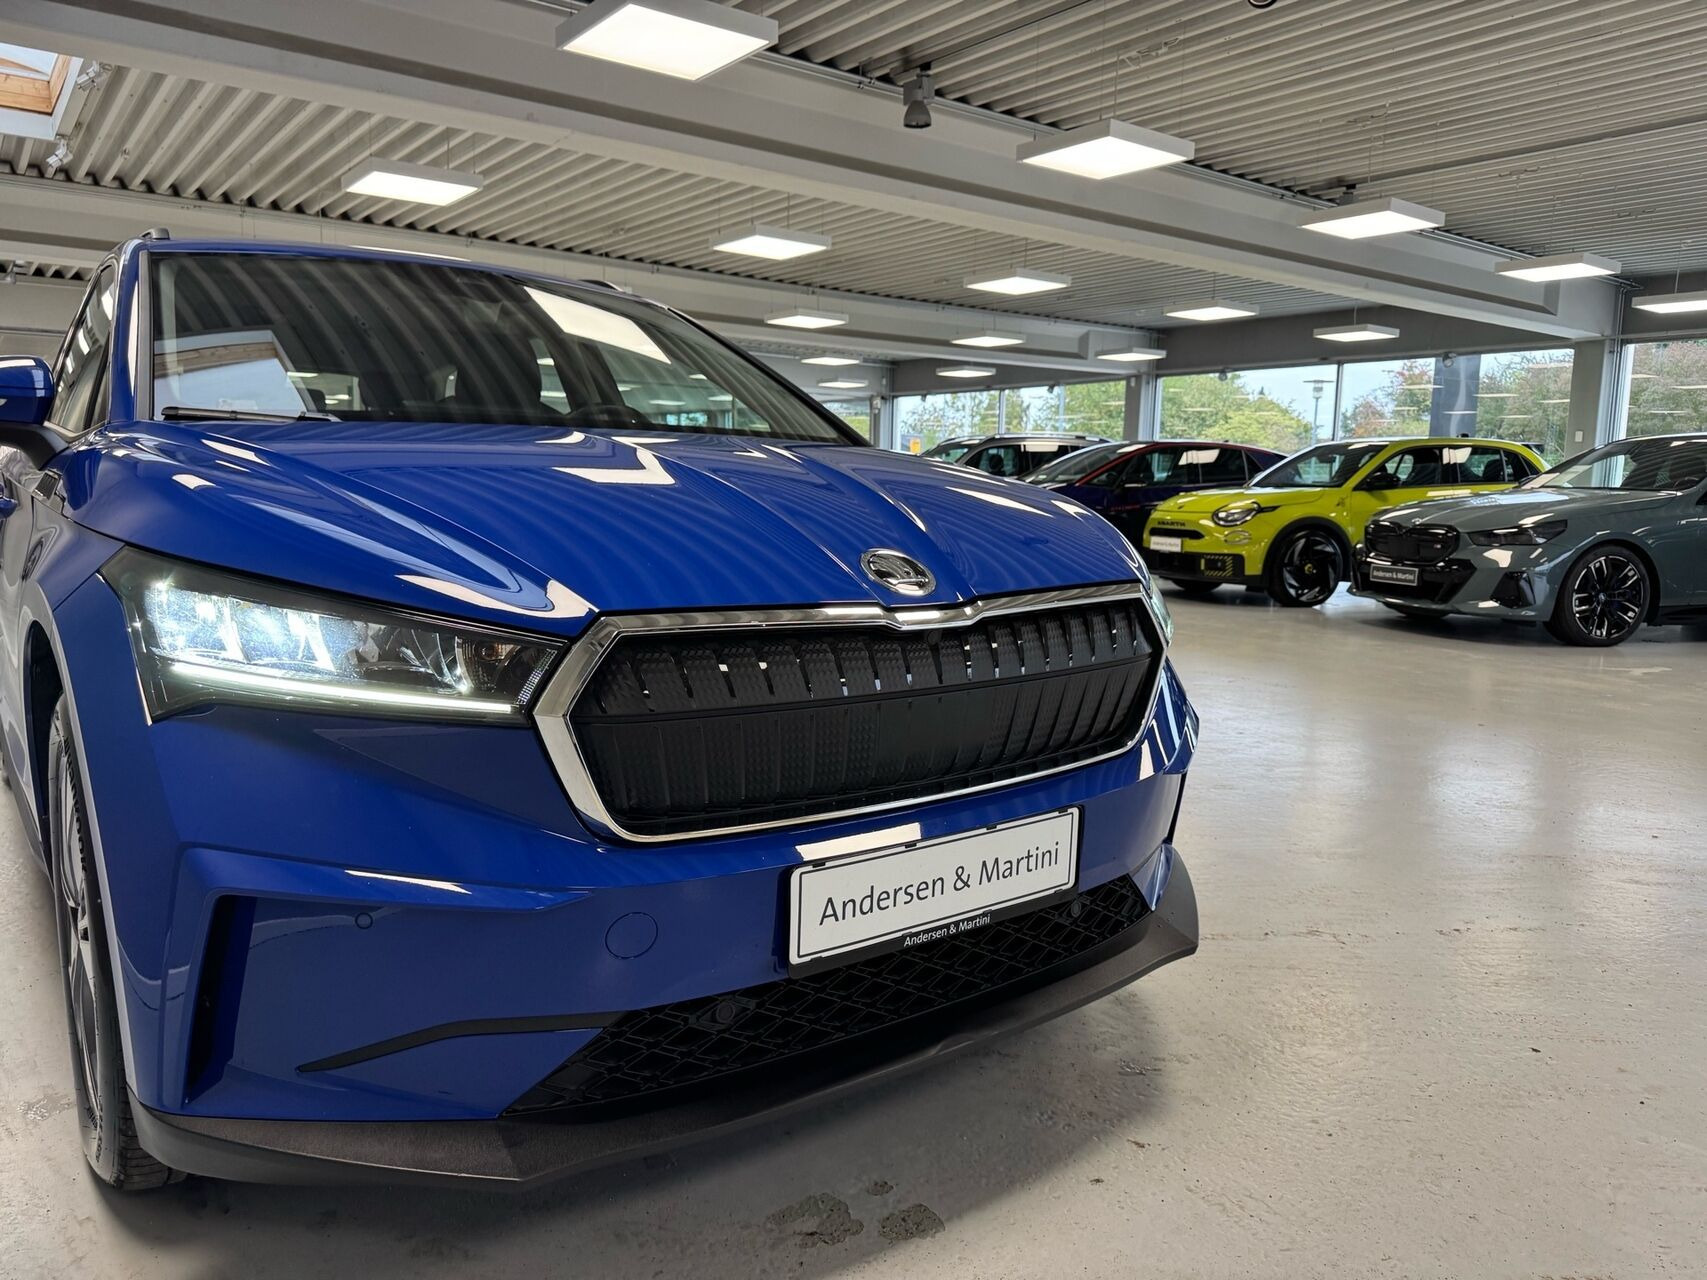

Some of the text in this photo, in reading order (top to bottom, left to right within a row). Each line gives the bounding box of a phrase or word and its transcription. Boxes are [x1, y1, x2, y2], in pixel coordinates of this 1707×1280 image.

[819, 841, 1060, 926] Andersen & Martini
[903, 913, 991, 947] Andersen & Martini
